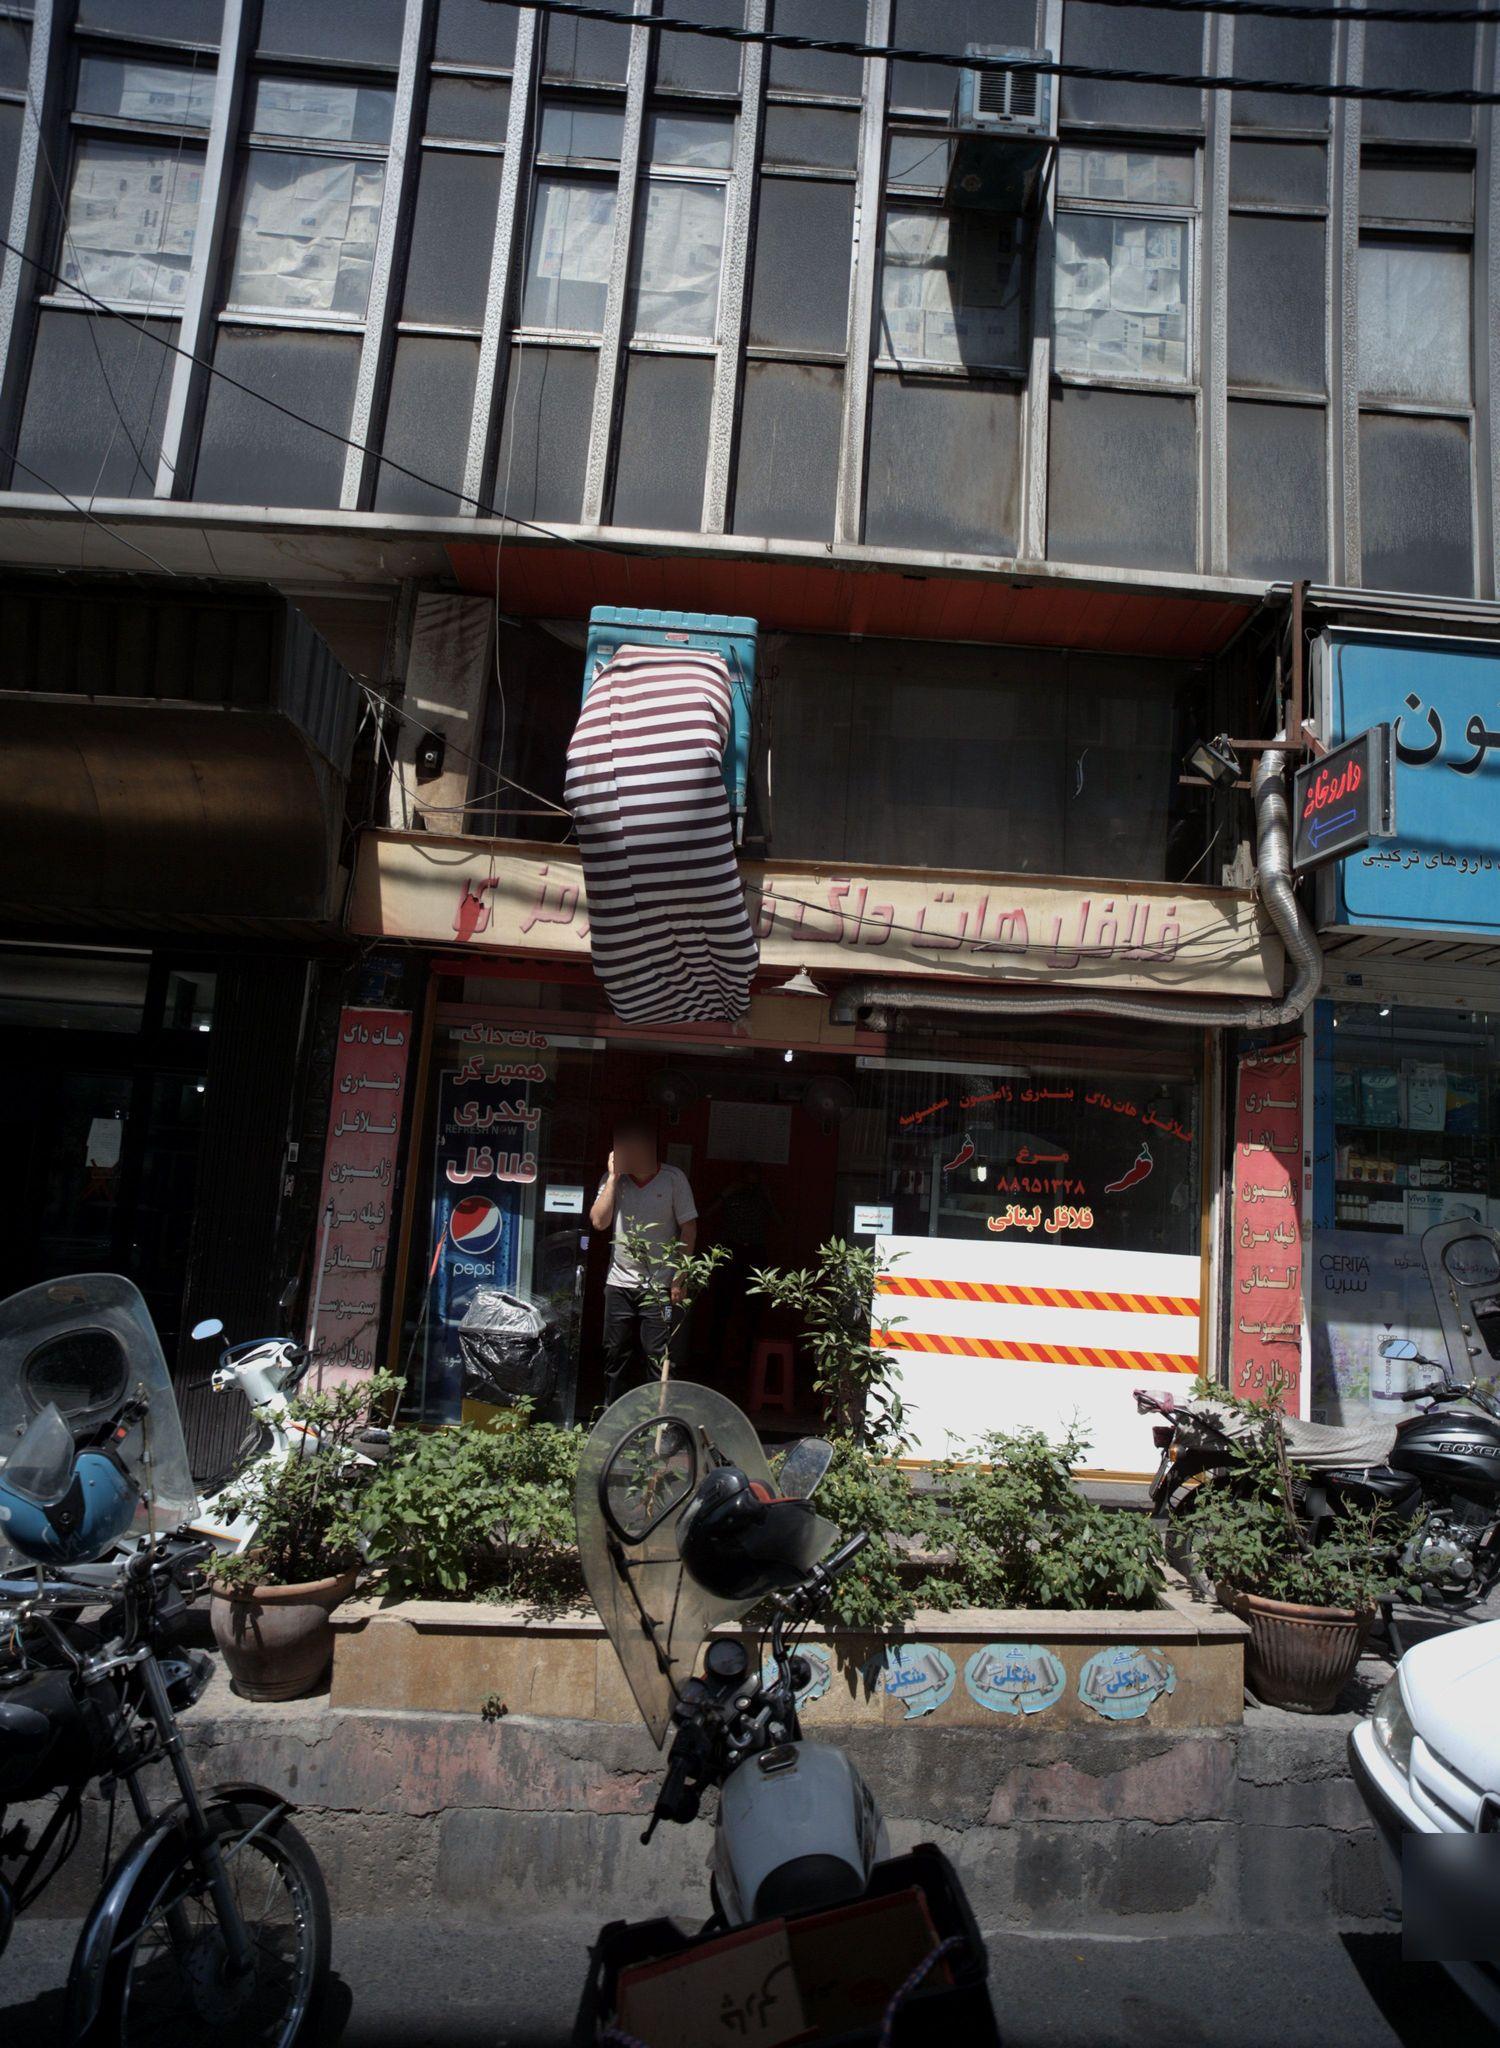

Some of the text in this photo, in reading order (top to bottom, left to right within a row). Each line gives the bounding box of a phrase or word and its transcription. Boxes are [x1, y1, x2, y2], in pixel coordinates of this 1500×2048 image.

[1395, 691, 1500, 775] ون
[1362, 849, 1493, 875] داروهای ترکیبی
[791, 876, 895, 945] داگ
[911, 891, 1030, 954] هات
[1046, 897, 1181, 969] فلافل
[343, 1023, 405, 1047] هات داگ
[507, 1029, 550, 1049] هات
[338, 1071, 402, 1096] بندری
[958, 1084, 1014, 1110] ژامبون
[1019, 1087, 1075, 1103] بندری
[333, 1108, 398, 1137] فلافل
[452, 1098, 542, 1131] بندری
[1015, 1145, 1071, 1165] مرغ
[1241, 1128, 1300, 1157] فلافل
[328, 1156, 393, 1187] ژامبون
[445, 1146, 539, 1185] فلافل
[996, 1175, 1087, 1196] ۸۸۹۵۱۳۲۸
[1241, 1178, 1299, 1207] ژامبون
[358, 1201, 386, 1231] فیله
[986, 1203, 1095, 1234] فلافل لبنانی
[1239, 1217, 1271, 1249] مرغ
[1273, 1220, 1298, 1250] فیله
[452, 1260, 496, 1277] pepsi
[1319, 1254, 1370, 1273] CERITA
[1239, 1264, 1299, 1295] آلمانی
[315, 1296, 377, 1320] سمبوس
[1237, 1315, 1296, 1342] سمبوسه
